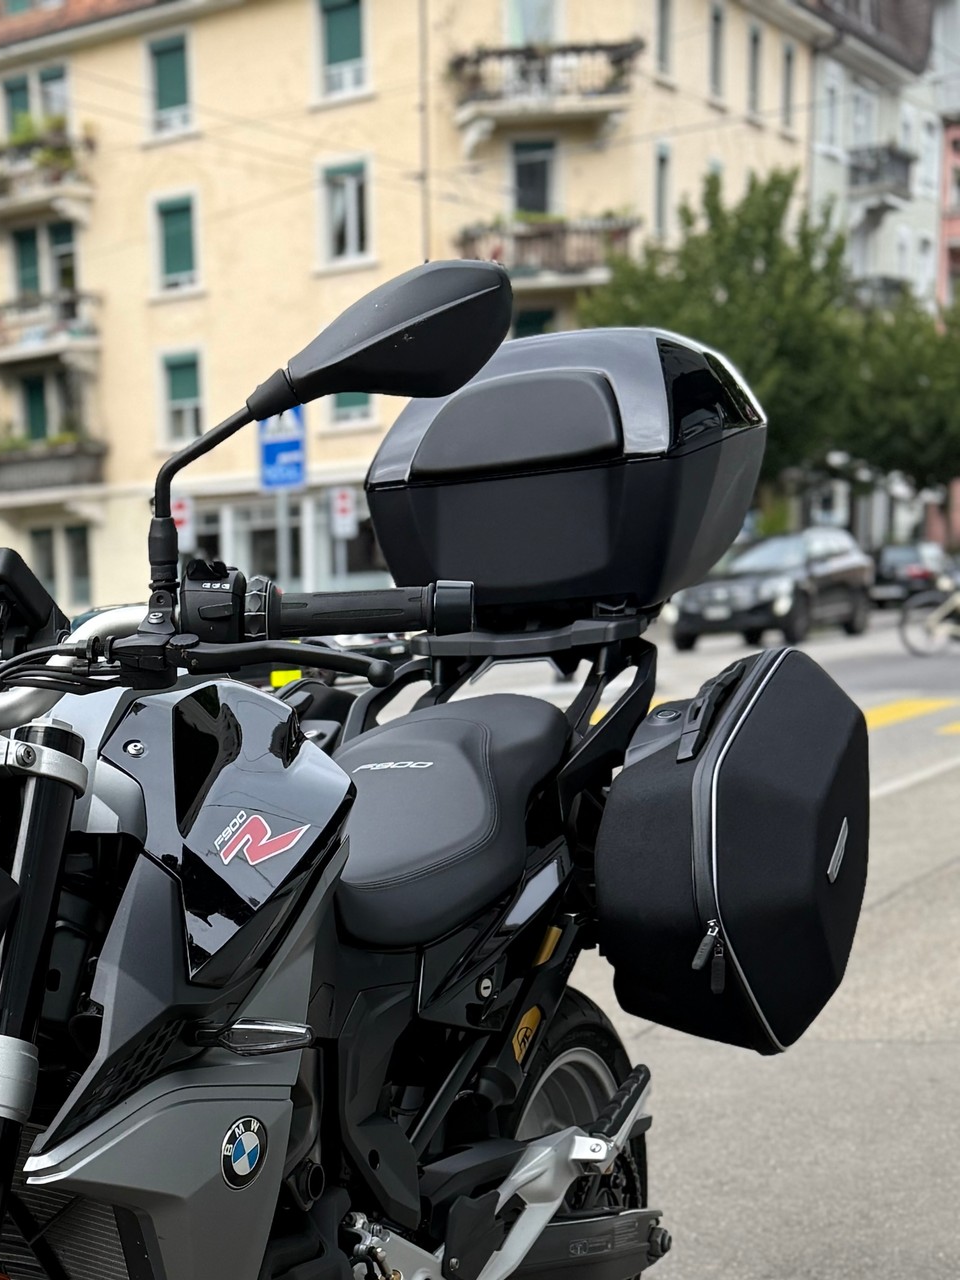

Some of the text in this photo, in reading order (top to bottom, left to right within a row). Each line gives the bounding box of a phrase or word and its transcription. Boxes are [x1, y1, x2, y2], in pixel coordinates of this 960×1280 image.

[351, 761, 434, 774] F900
[213, 810, 247, 851] F900
[220, 814, 312, 866] R
[224, 1119, 260, 1156] BMW
